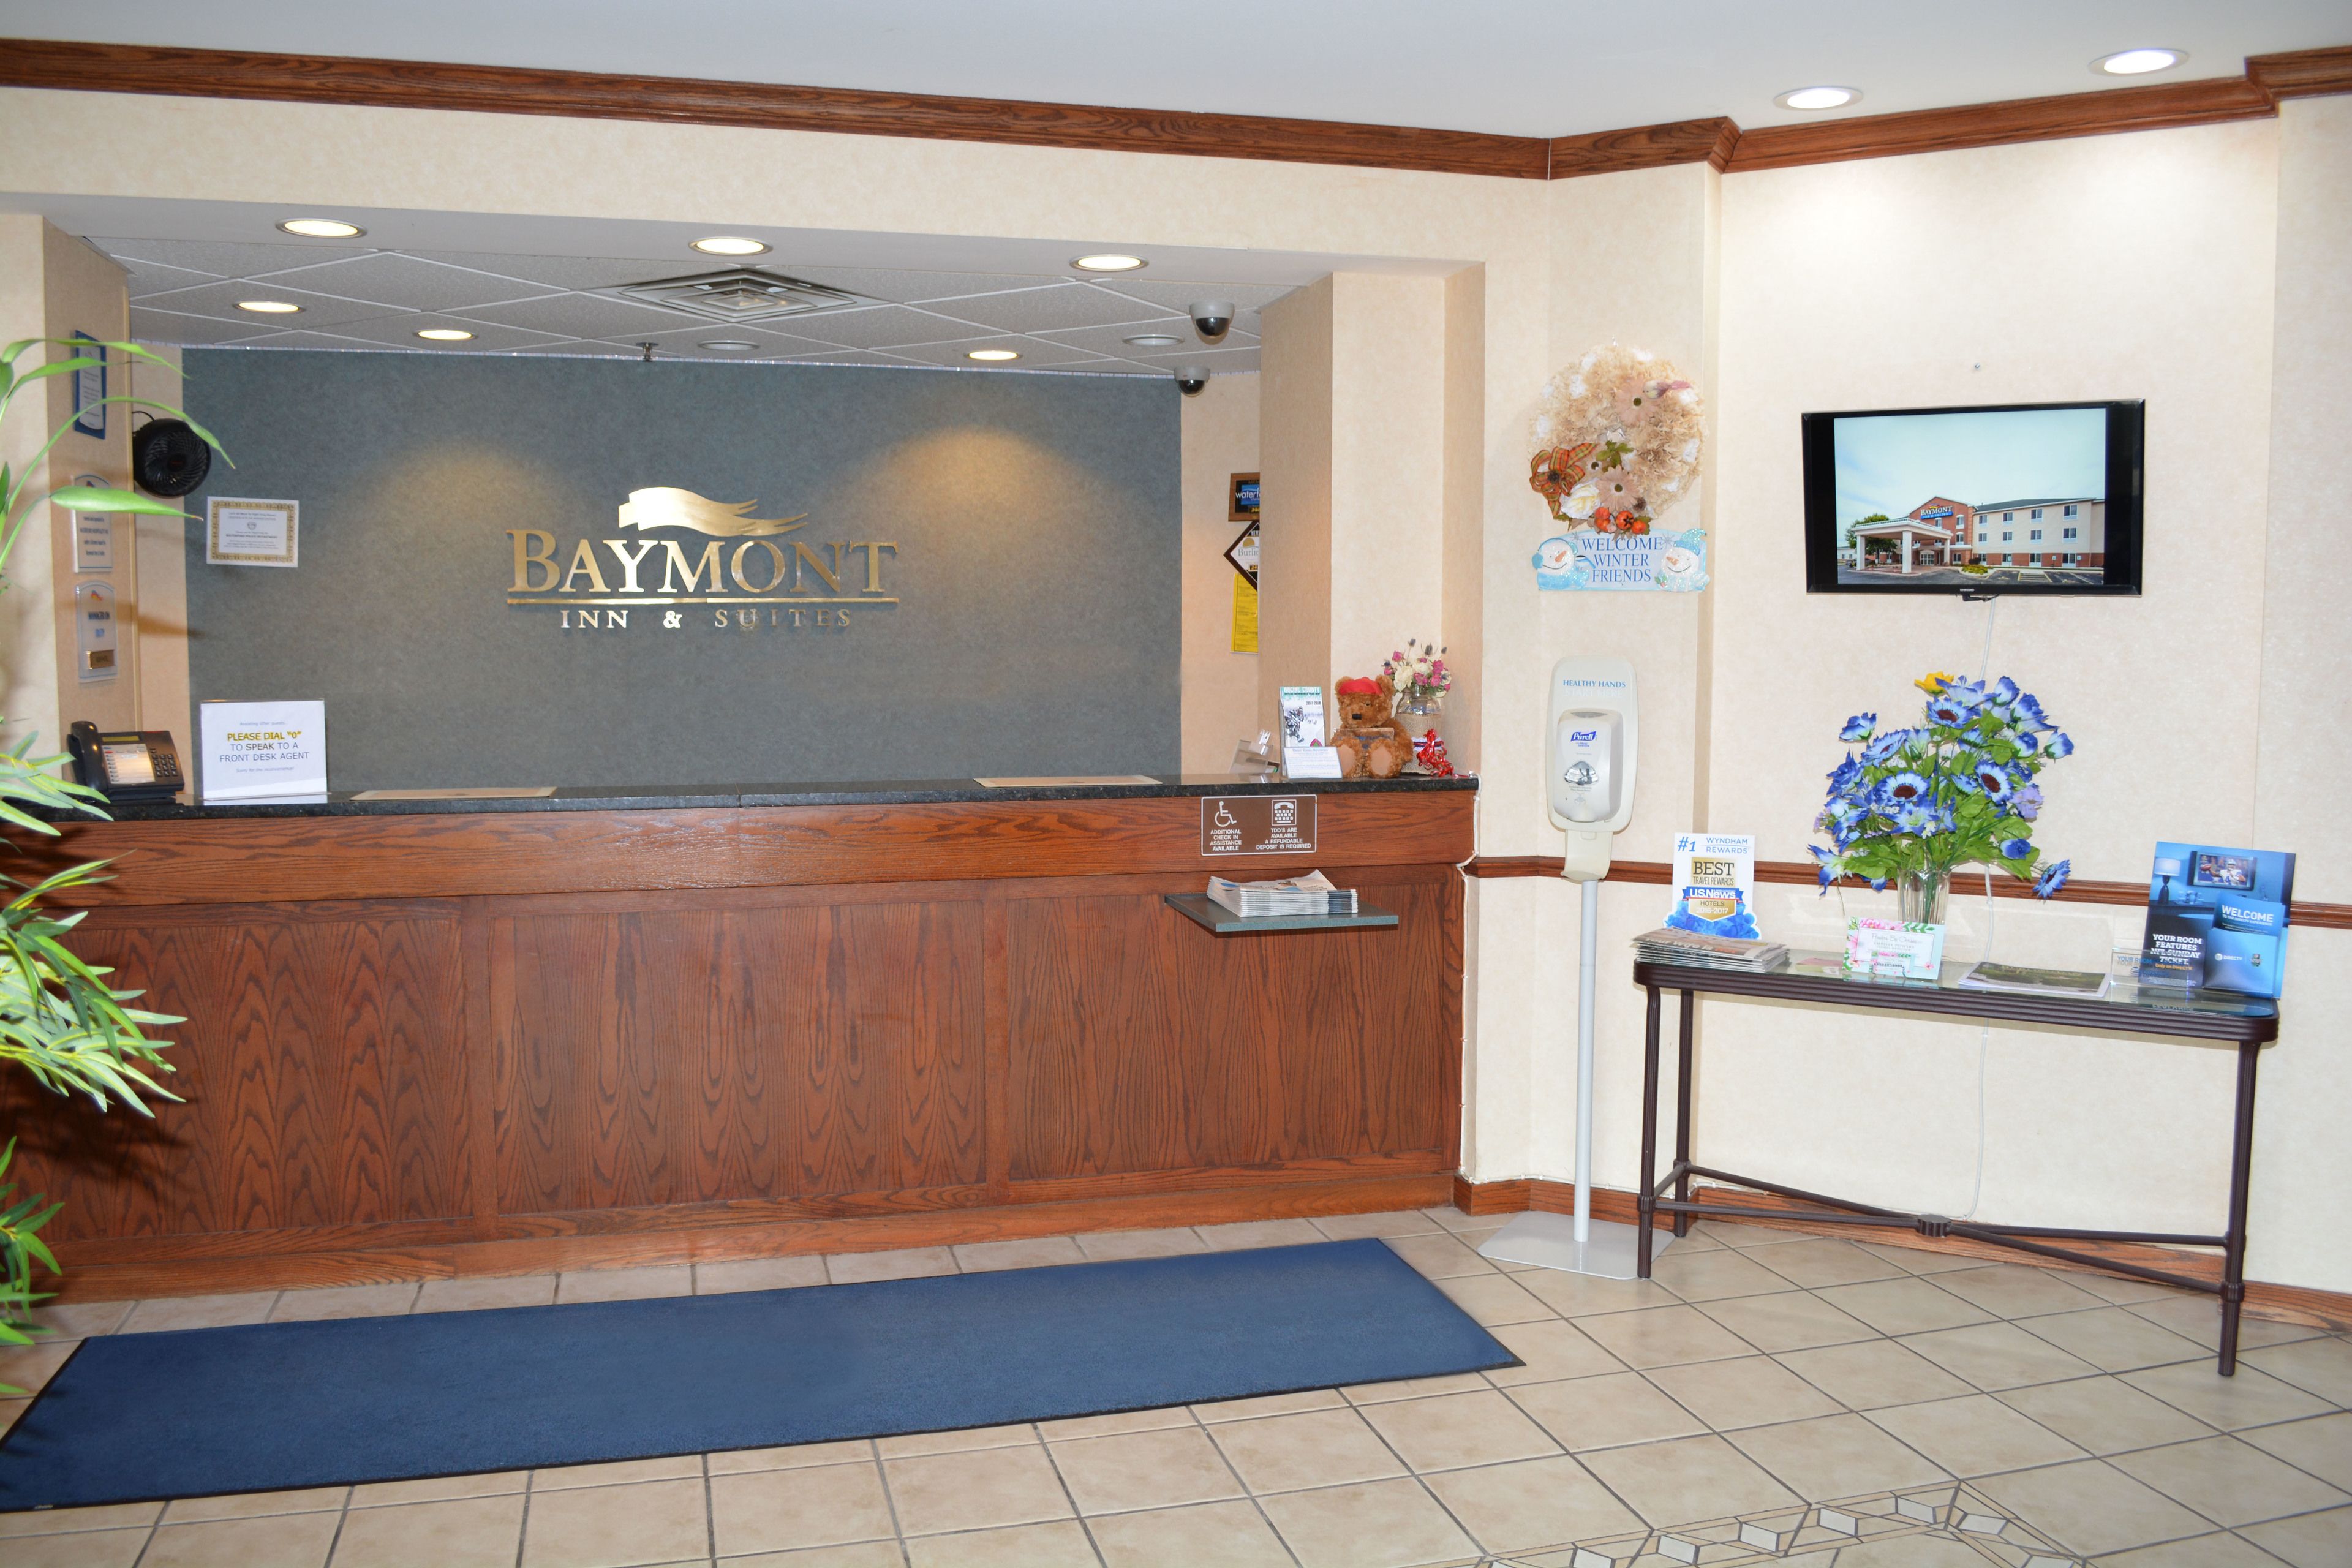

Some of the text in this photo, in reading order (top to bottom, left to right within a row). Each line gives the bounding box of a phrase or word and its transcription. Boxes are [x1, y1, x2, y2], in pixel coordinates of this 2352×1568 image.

[1235, 487, 1260, 499] waterf
[1921, 505, 1953, 515] BAYMONT
[1582, 537, 1664, 551] WELCOME
[506, 529, 899, 593] BAYMONT
[1594, 554, 1649, 567] WINTER
[1593, 569, 1651, 582] FRIENDS
[560, 609, 851, 628] INN & SUITES
[227, 732, 261, 741] PLEASE
[263, 731, 285, 740] DIAL
[1678, 836, 1696, 852] #1
[1693, 861, 1735, 876] BEST
[1693, 876, 1734, 886] TRAVEL REWARDS
[2222, 905, 2274, 922] WELCOME
[2155, 941, 2198, 951] FEATURES
[2166, 949, 2201, 959] SUNDAY
